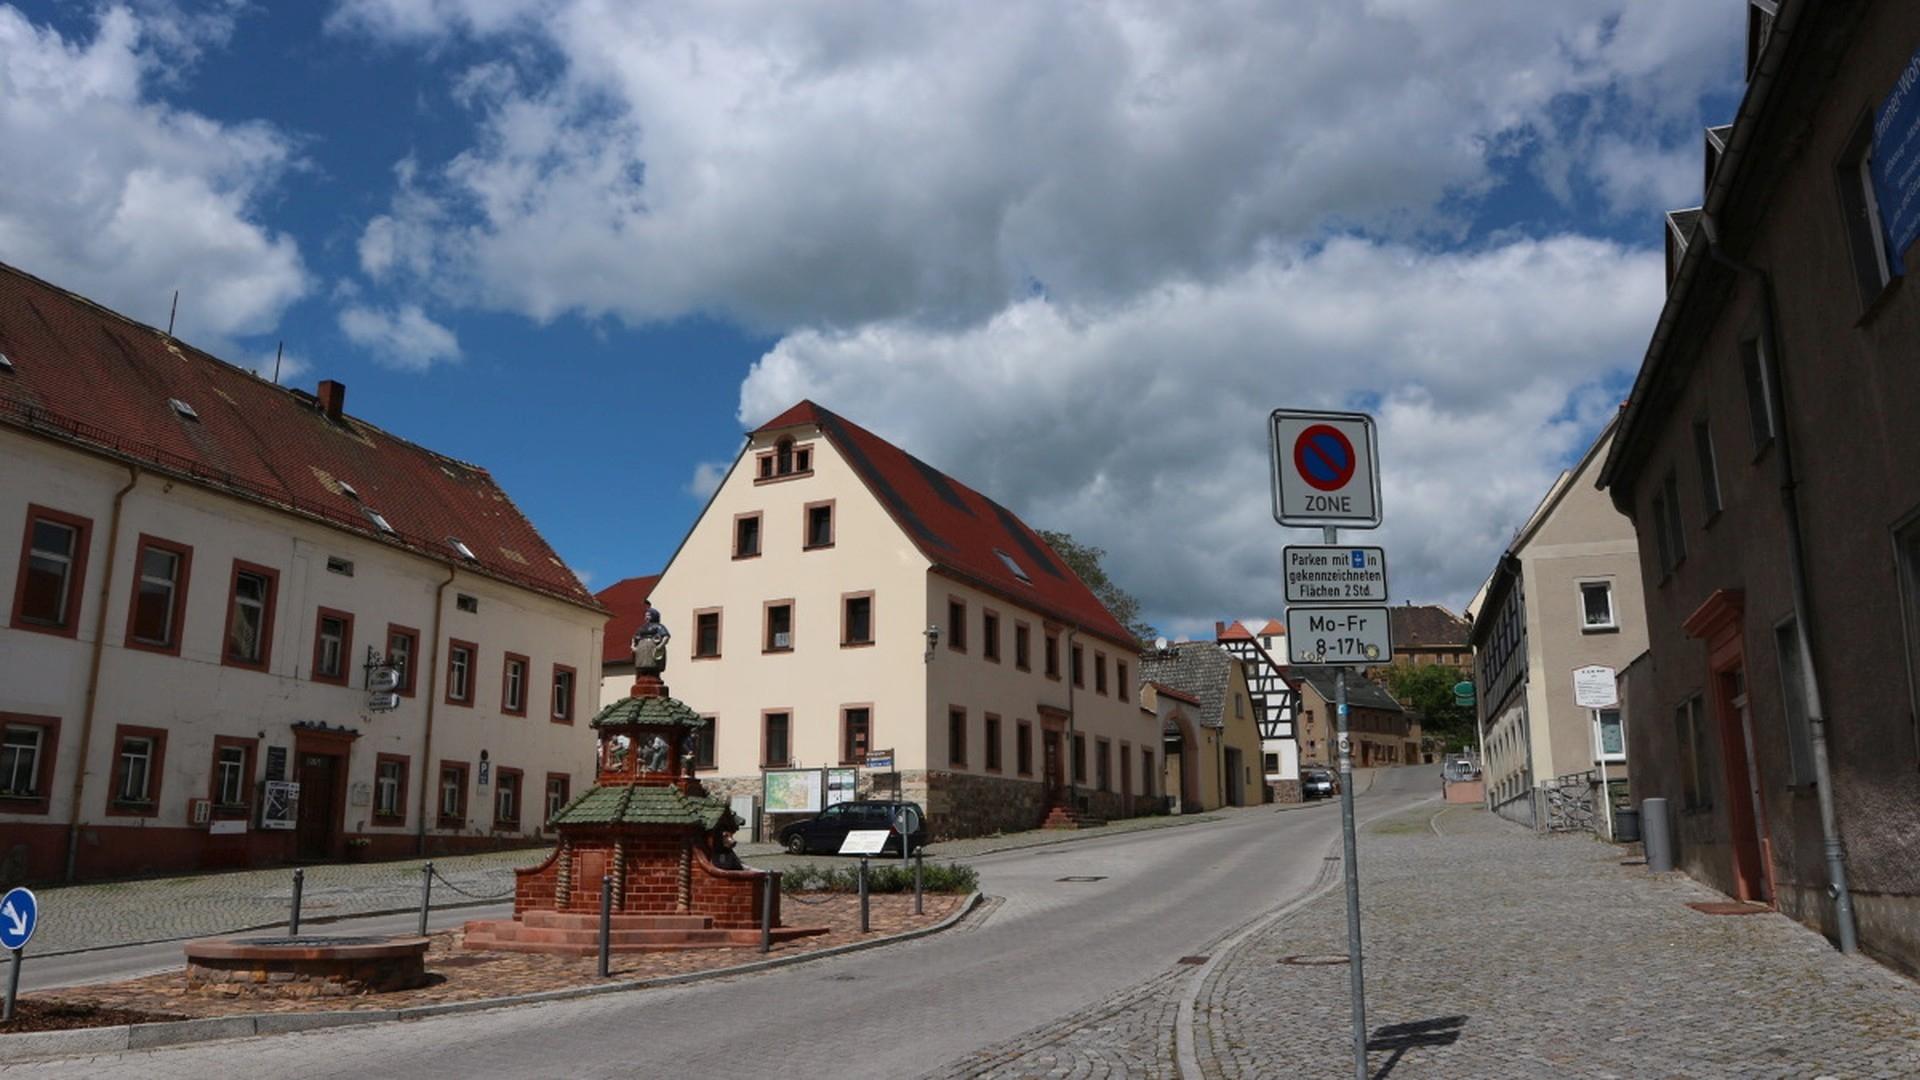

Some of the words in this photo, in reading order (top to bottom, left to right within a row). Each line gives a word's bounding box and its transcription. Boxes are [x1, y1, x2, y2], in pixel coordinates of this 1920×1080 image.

[1305, 495, 1352, 512] ZONE
[1292, 553, 1327, 565] Parken
[1332, 553, 1349, 565] mit
[1367, 553, 1377, 565] in
[1289, 569, 1380, 584] gekennzeichneten
[1300, 585, 1340, 597] Flächen
[1345, 585, 1351, 597] 2
[1309, 615, 1367, 632] Mo-Fr
